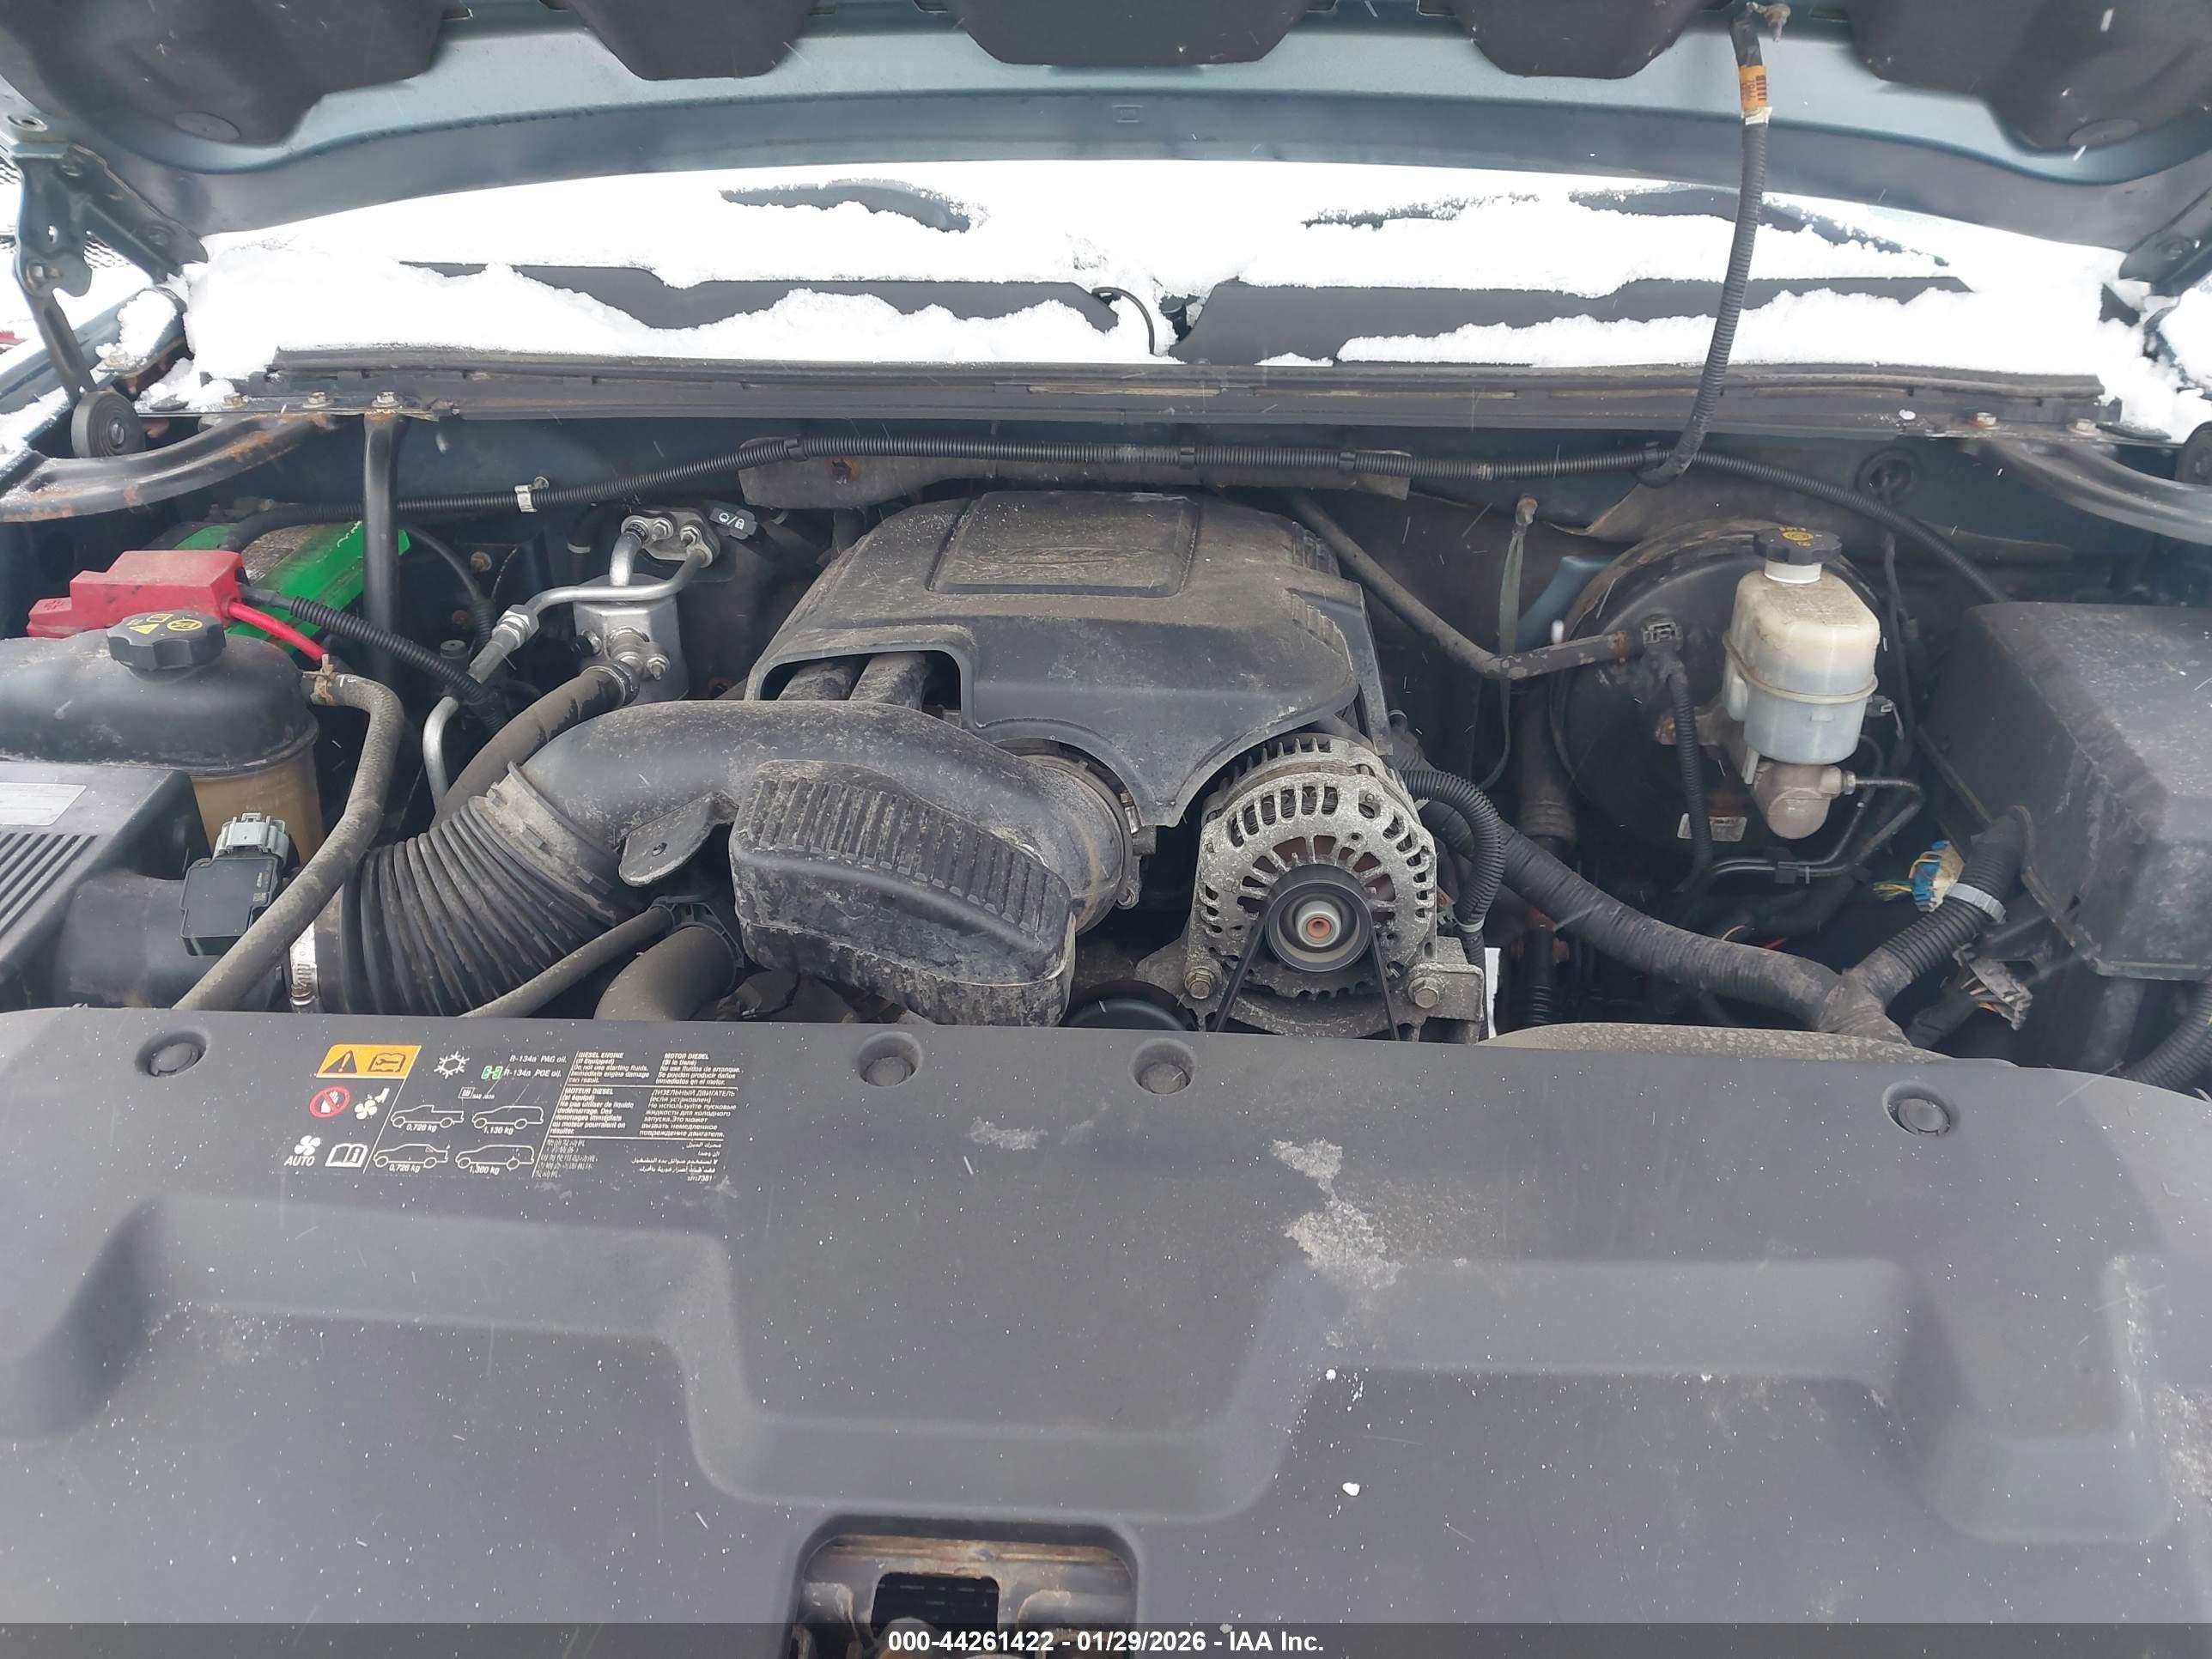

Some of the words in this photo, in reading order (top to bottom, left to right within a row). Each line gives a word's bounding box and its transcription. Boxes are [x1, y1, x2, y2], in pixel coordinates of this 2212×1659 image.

[427, 1124, 437, 1133] kg
[502, 1126, 514, 1135] kg
[284, 1155, 315, 1167] AUTO
[410, 1164, 421, 1173] kg
[489, 1165, 500, 1176] kg
